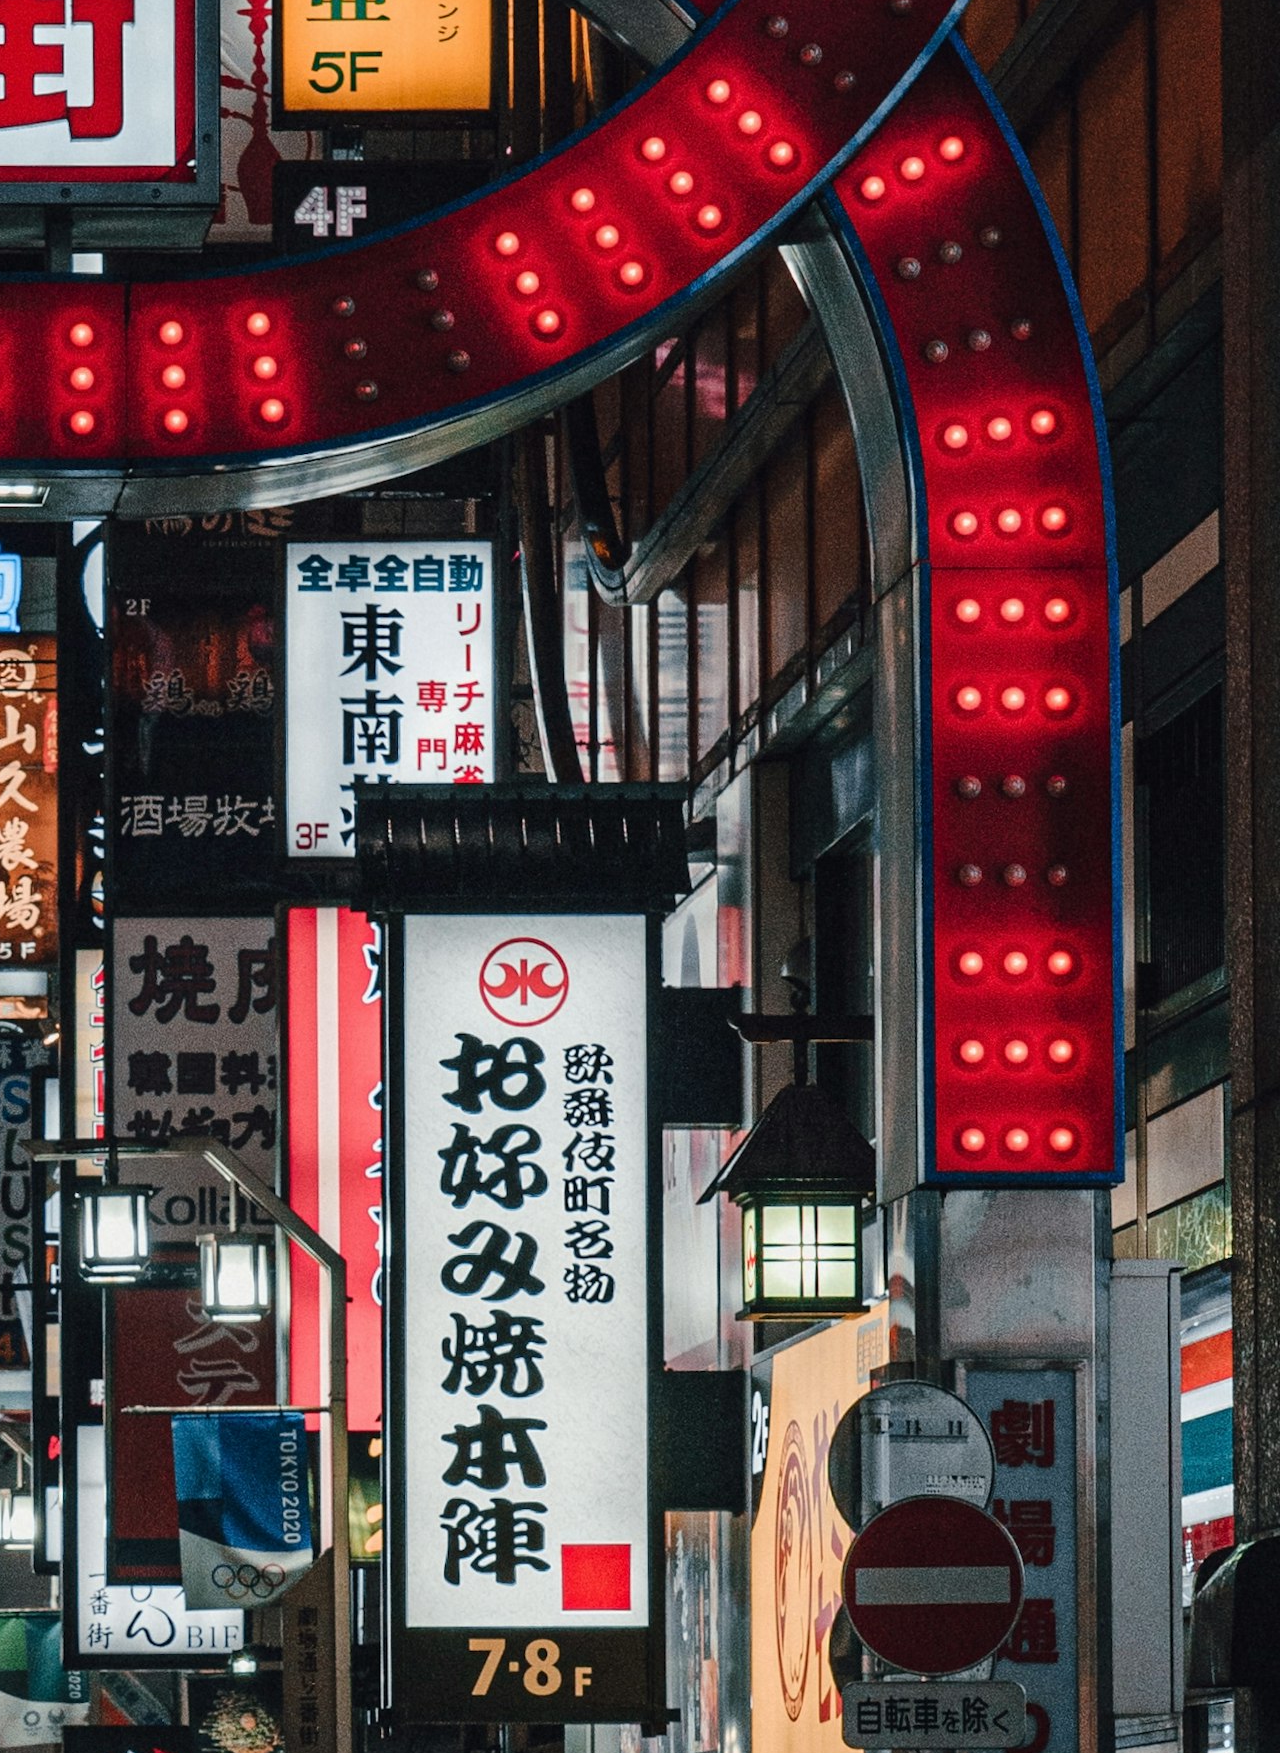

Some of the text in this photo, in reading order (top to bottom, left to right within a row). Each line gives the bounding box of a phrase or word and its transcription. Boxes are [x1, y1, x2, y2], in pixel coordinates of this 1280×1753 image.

[308, 51, 383, 95] 5F
[294, 185, 368, 237] 4F
[296, 553, 485, 594] 全卓全自動
[125, 598, 152, 617] 2F
[416, 680, 448, 771] 専門
[295, 822, 330, 851] 3F
[561, 1043, 615, 1306] 歌舞伎町名物
[437, 1032, 552, 1587] お好み焼本陣
[279, 1428, 301, 1544] TOKYO 2020
[186, 1623, 240, 1649] B1F
[855, 1695, 1011, 1738] 自転車を除く
